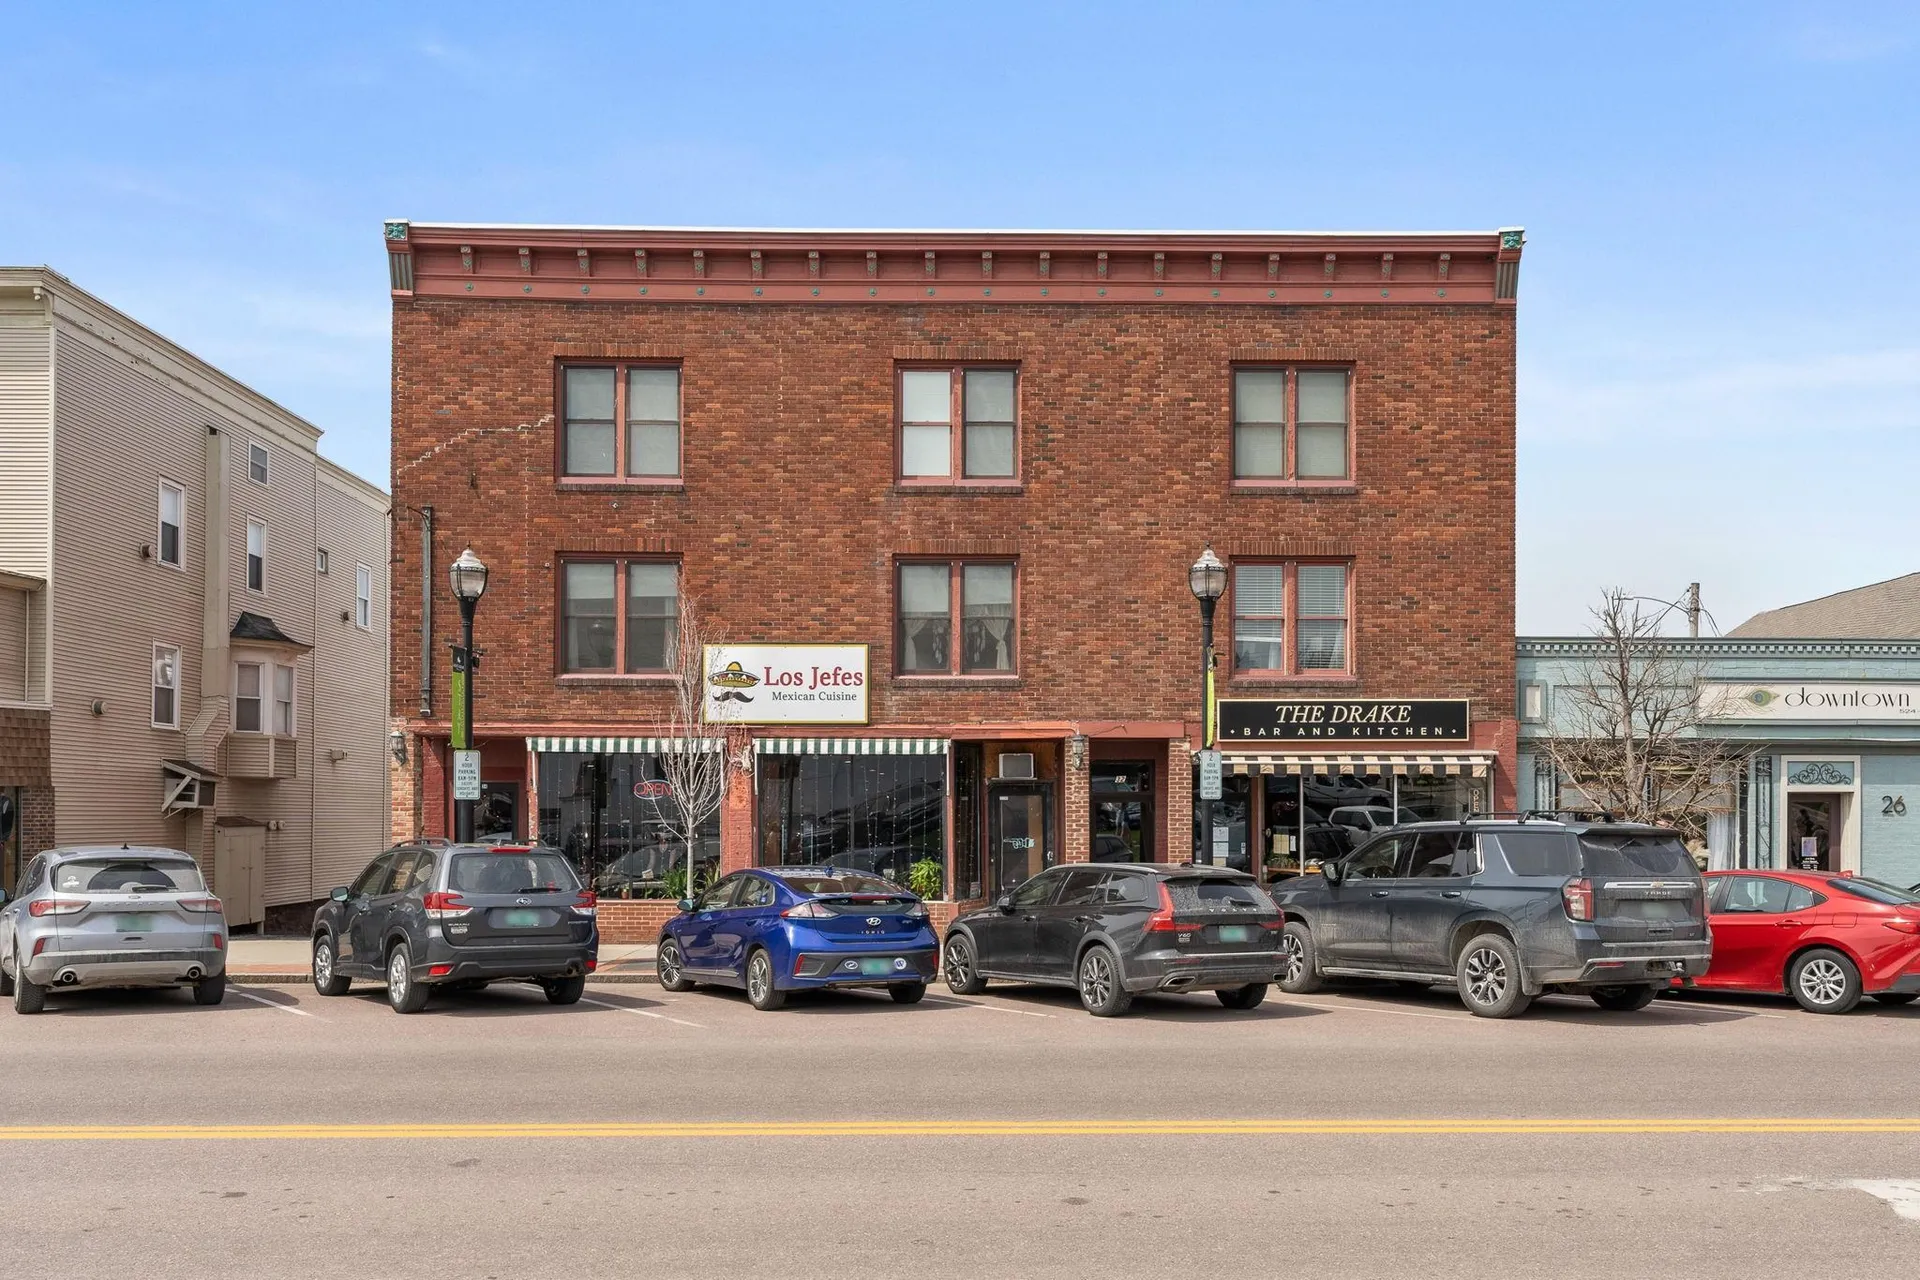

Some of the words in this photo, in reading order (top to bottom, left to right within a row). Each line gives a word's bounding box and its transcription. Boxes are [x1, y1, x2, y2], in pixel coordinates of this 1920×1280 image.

[763, 666, 803, 686] Los
[809, 666, 863, 690] Jefes
[772, 691, 815, 701] Mexican
[818, 691, 857, 701] Cuisine
[1275, 705, 1325, 723] THE
[1329, 705, 1412, 723] DRAKE
[1244, 727, 1281, 736] BAR
[1297, 727, 1336, 736] AND
[1353, 727, 1443, 736] KITCHEN
[633, 782, 673, 797] OPEN
[1881, 795, 1906, 814] 26
